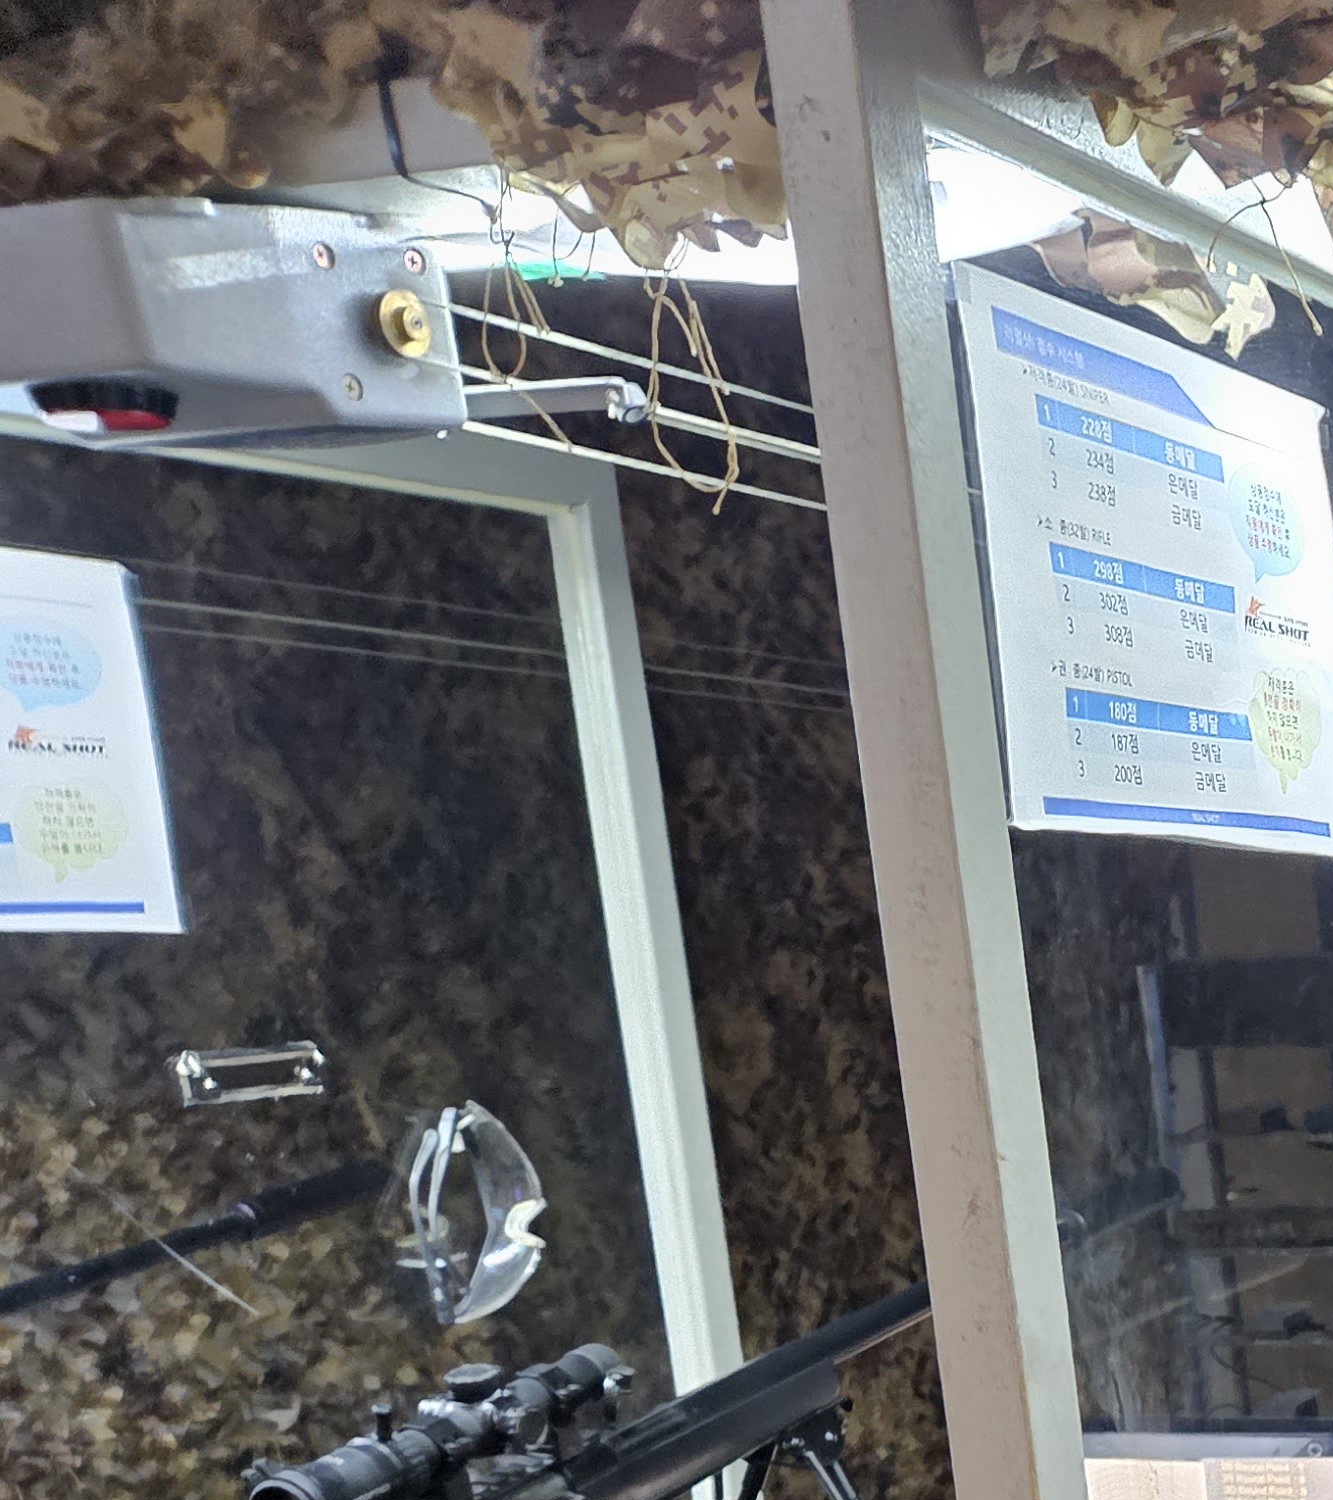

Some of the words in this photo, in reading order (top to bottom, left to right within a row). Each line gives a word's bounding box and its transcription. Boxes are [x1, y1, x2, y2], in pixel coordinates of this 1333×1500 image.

[1044, 404, 1050, 422] 1
[1049, 437, 1056, 456] 2
[1086, 448, 1115, 475] 234점
[1052, 470, 1058, 489] 3
[1058, 552, 1065, 569] 1
[1093, 559, 1124, 585] 298점
[1062, 584, 1070, 602] 2
[1099, 592, 1129, 616] 302점
[1067, 616, 1075, 635] 3
[1104, 624, 1133, 648] 308점
[1245, 614, 1276, 634] REAL
[1278, 623, 1309, 642] SHOT
[1106, 667, 1133, 687] PISTOL
[1073, 695, 1079, 713] 1
[1108, 701, 1138, 723] 180점
[1188, 711, 1219, 735] 동메달
[1075, 728, 1082, 746] 2
[1111, 733, 1139, 755] 187점
[1191, 741, 1222, 764] 은메달
[1078, 760, 1085, 777] 3
[1114, 764, 1143, 786] 200점
[1195, 771, 1227, 793] 금메달
